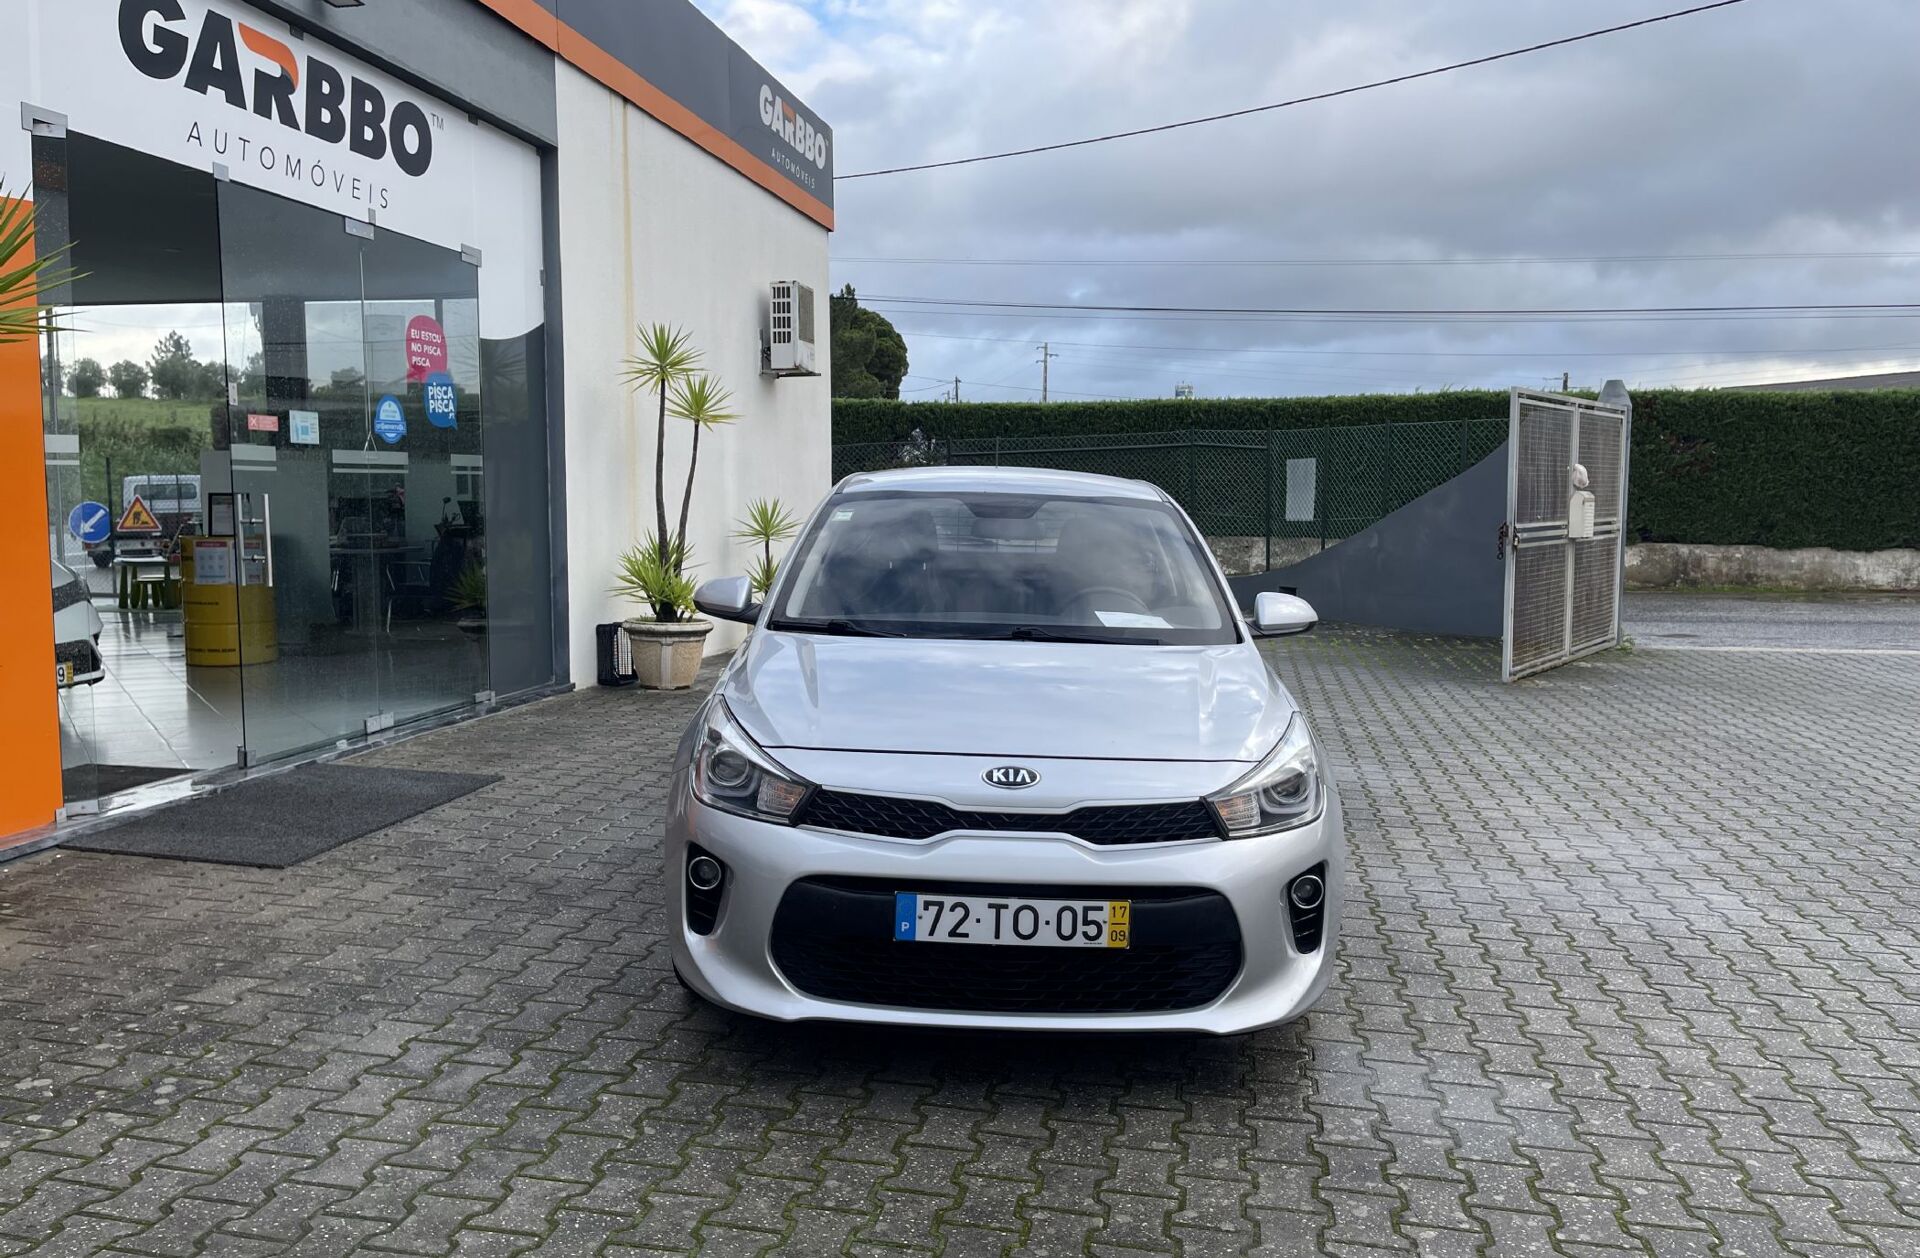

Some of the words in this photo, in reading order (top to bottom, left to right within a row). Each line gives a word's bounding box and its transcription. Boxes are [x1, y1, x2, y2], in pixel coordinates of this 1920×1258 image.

[118, 0, 432, 177] GARBBO
[760, 84, 826, 169] GARBBO
[187, 121, 389, 209] AUTOMÓVEIS
[411, 329, 420, 339] EU
[421, 331, 442, 343] ESTOU
[411, 342, 422, 352] NO
[423, 345, 442, 356] PISCA
[412, 355, 431, 368] PISCA
[429, 399, 455, 414] PISCA
[992, 768, 1031, 783] KIA
[1111, 905, 1127, 919] 17
[900, 921, 910, 932] P
[1110, 929, 1127, 942] 09
